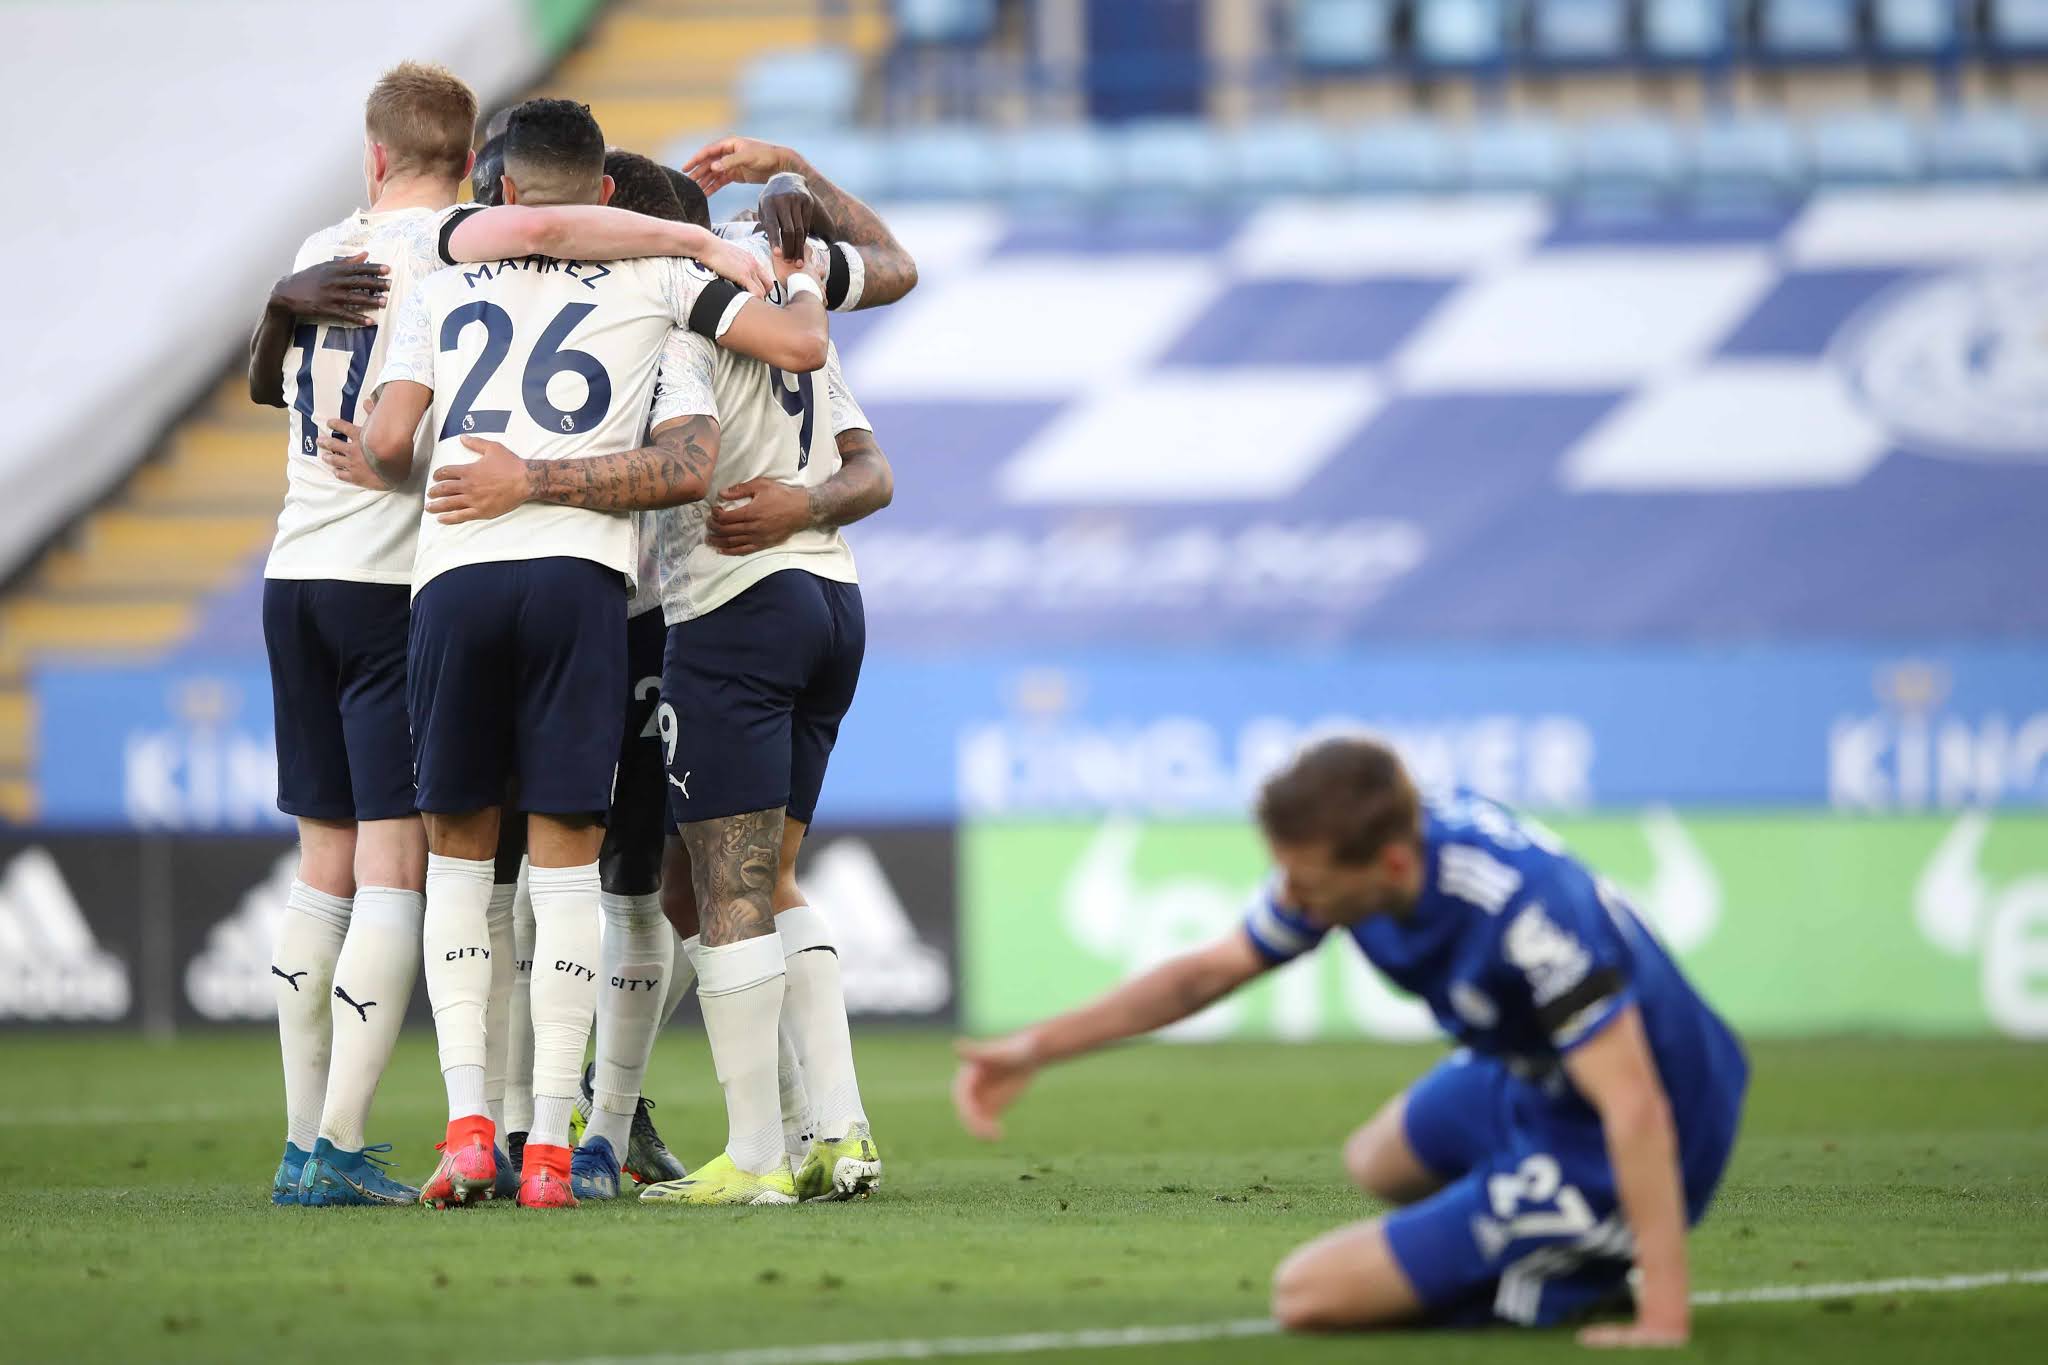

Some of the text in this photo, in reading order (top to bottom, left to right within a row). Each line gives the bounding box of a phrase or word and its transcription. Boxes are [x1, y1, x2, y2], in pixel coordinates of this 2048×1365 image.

[290, 323, 379, 457] 17
[438, 300, 612, 441] 26
[658, 702, 679, 766] 9
[445, 947, 490, 961] CITY
[555, 960, 596, 982] CITY
[611, 976, 658, 992] CITY
